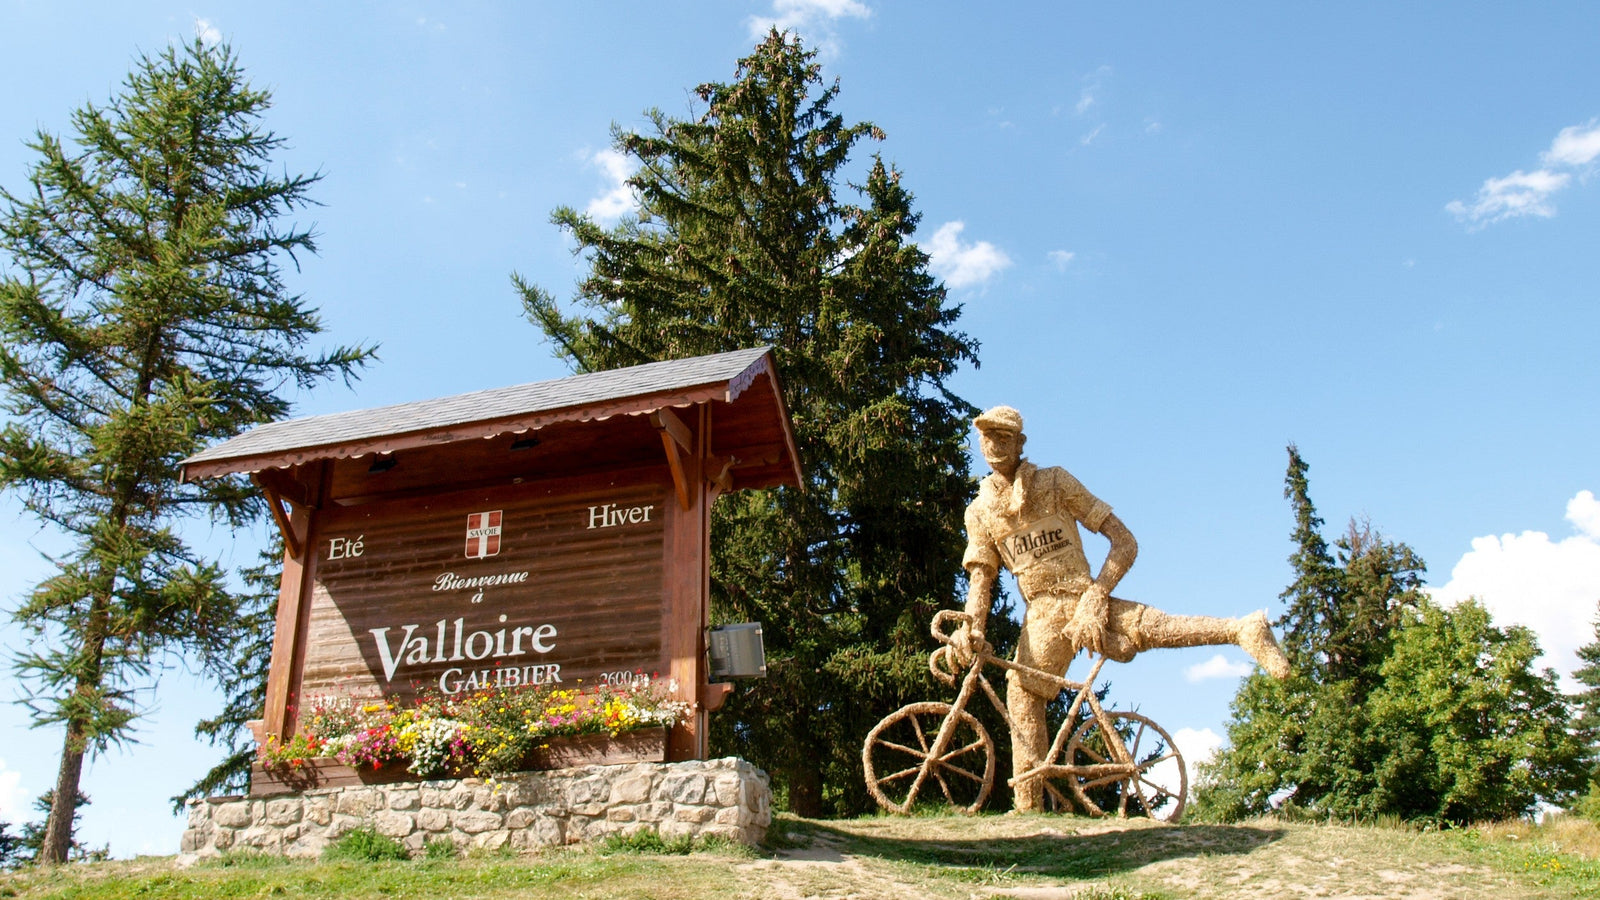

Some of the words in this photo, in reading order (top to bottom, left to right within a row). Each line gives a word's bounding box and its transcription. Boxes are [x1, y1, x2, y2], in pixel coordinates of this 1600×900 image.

[587, 503, 654, 529] Hiver
[470, 528, 497, 538] SAVOIE
[327, 535, 364, 560] Eté
[1002, 529, 1063, 563] Valloire
[1033, 539, 1072, 558] GALIBIER
[432, 571, 529, 591] Bienvenue
[472, 588, 484, 604] à
[369, 614, 558, 683] Valloire
[439, 663, 562, 695] GALIBIER
[599, 670, 632, 688] 2600
